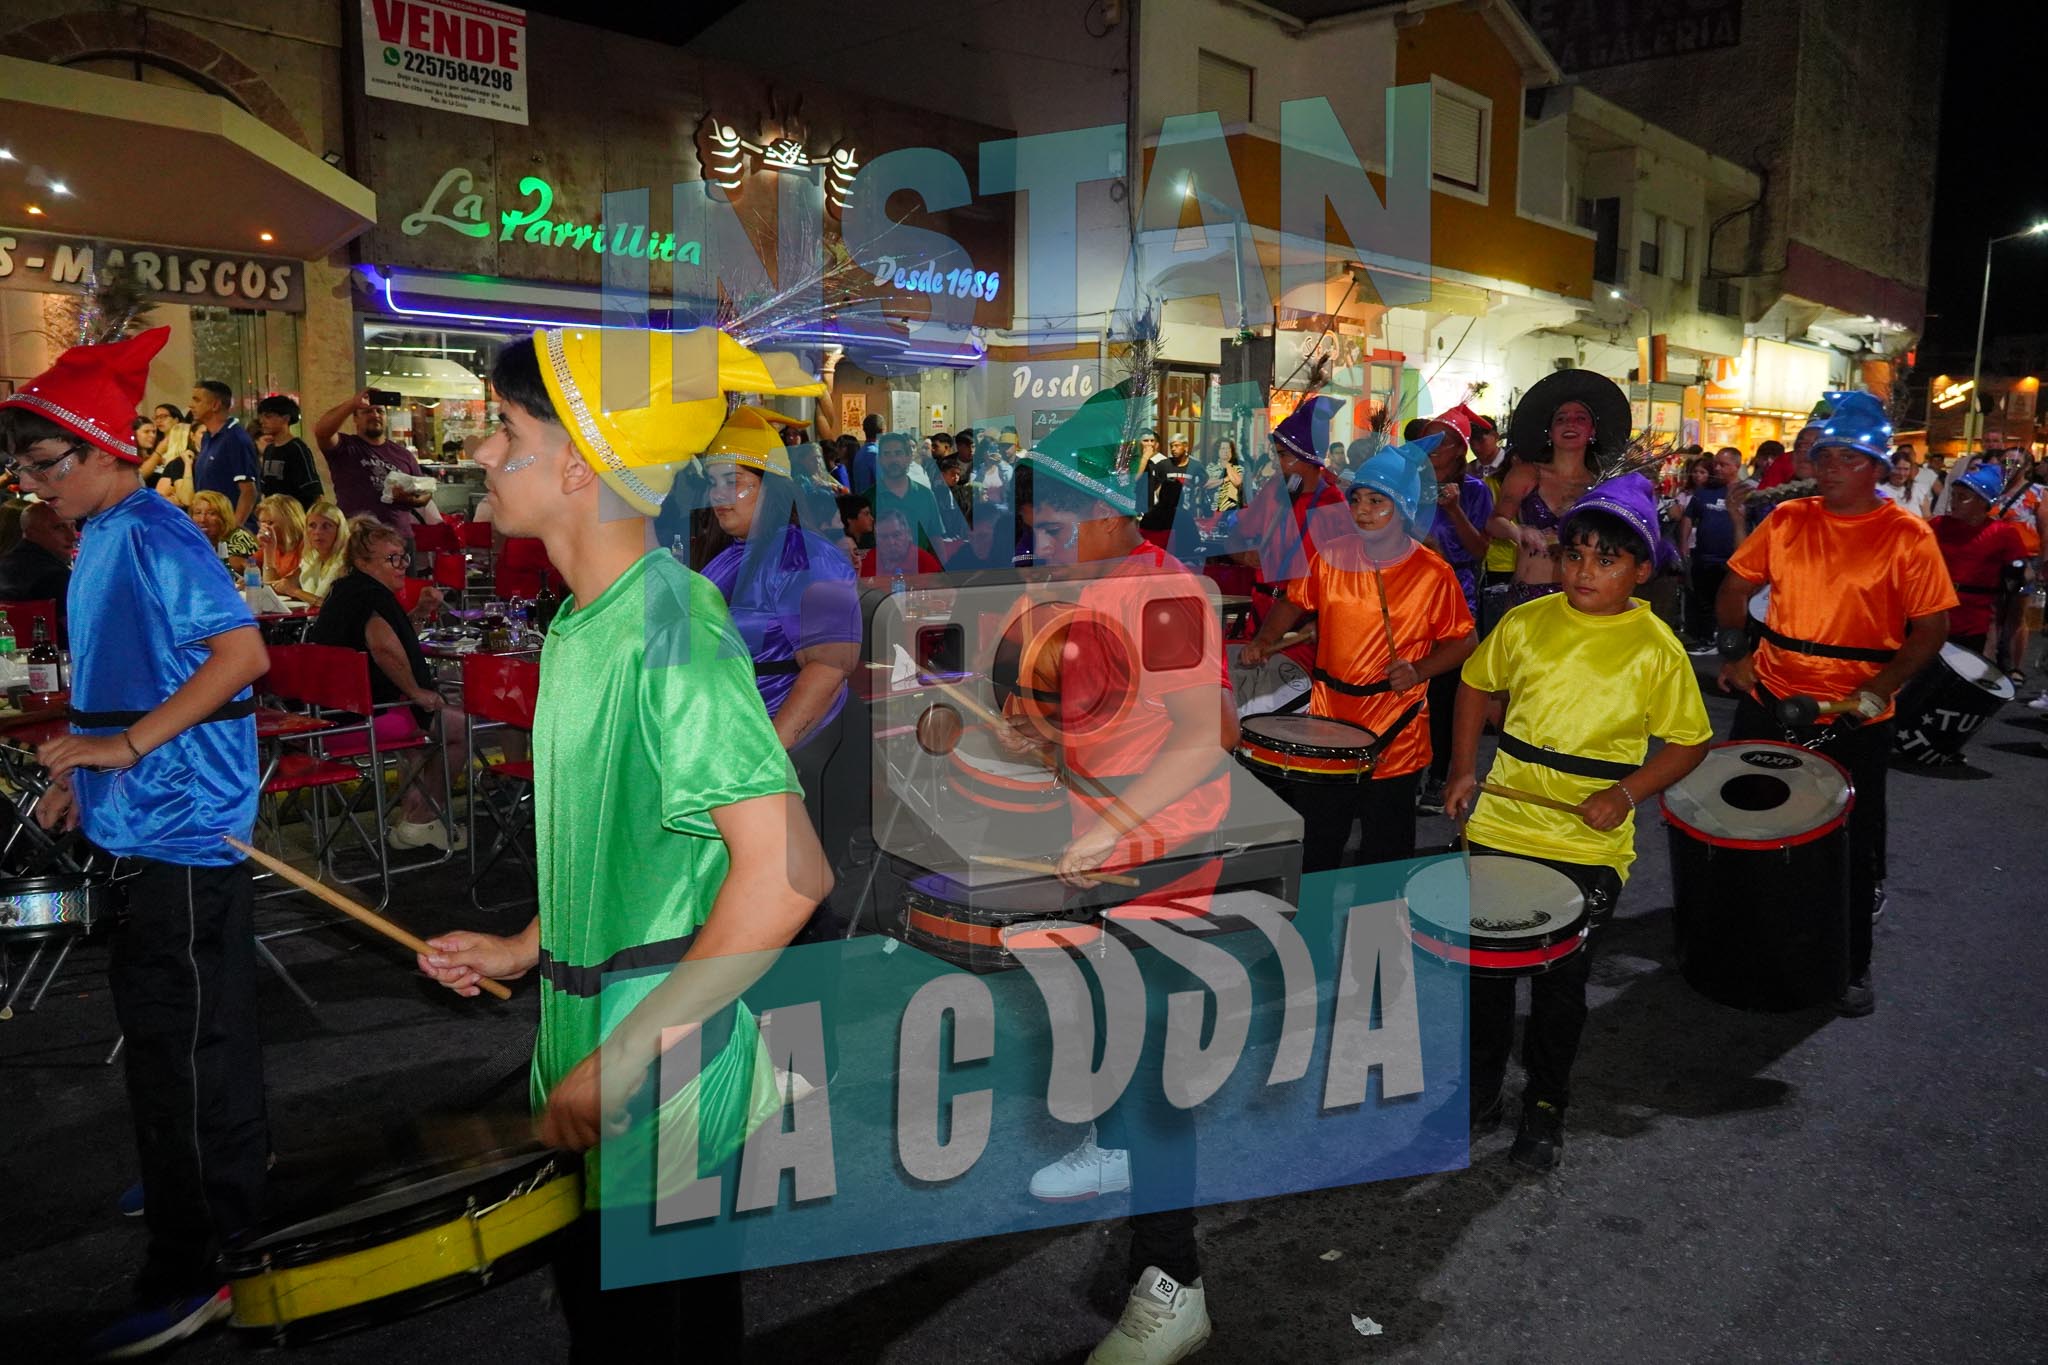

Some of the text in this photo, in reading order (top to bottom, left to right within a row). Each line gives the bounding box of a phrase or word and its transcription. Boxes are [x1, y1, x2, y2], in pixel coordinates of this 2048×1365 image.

[371, 0, 519, 71] VENDE
[403, 50, 513, 92] 2257584298
[401, 167, 701, 266] La Parrillita
[52, 245, 291, 300] MARISCOS
[874, 256, 1000, 302] Desde 1989
[1013, 365, 1093, 399] Desde
